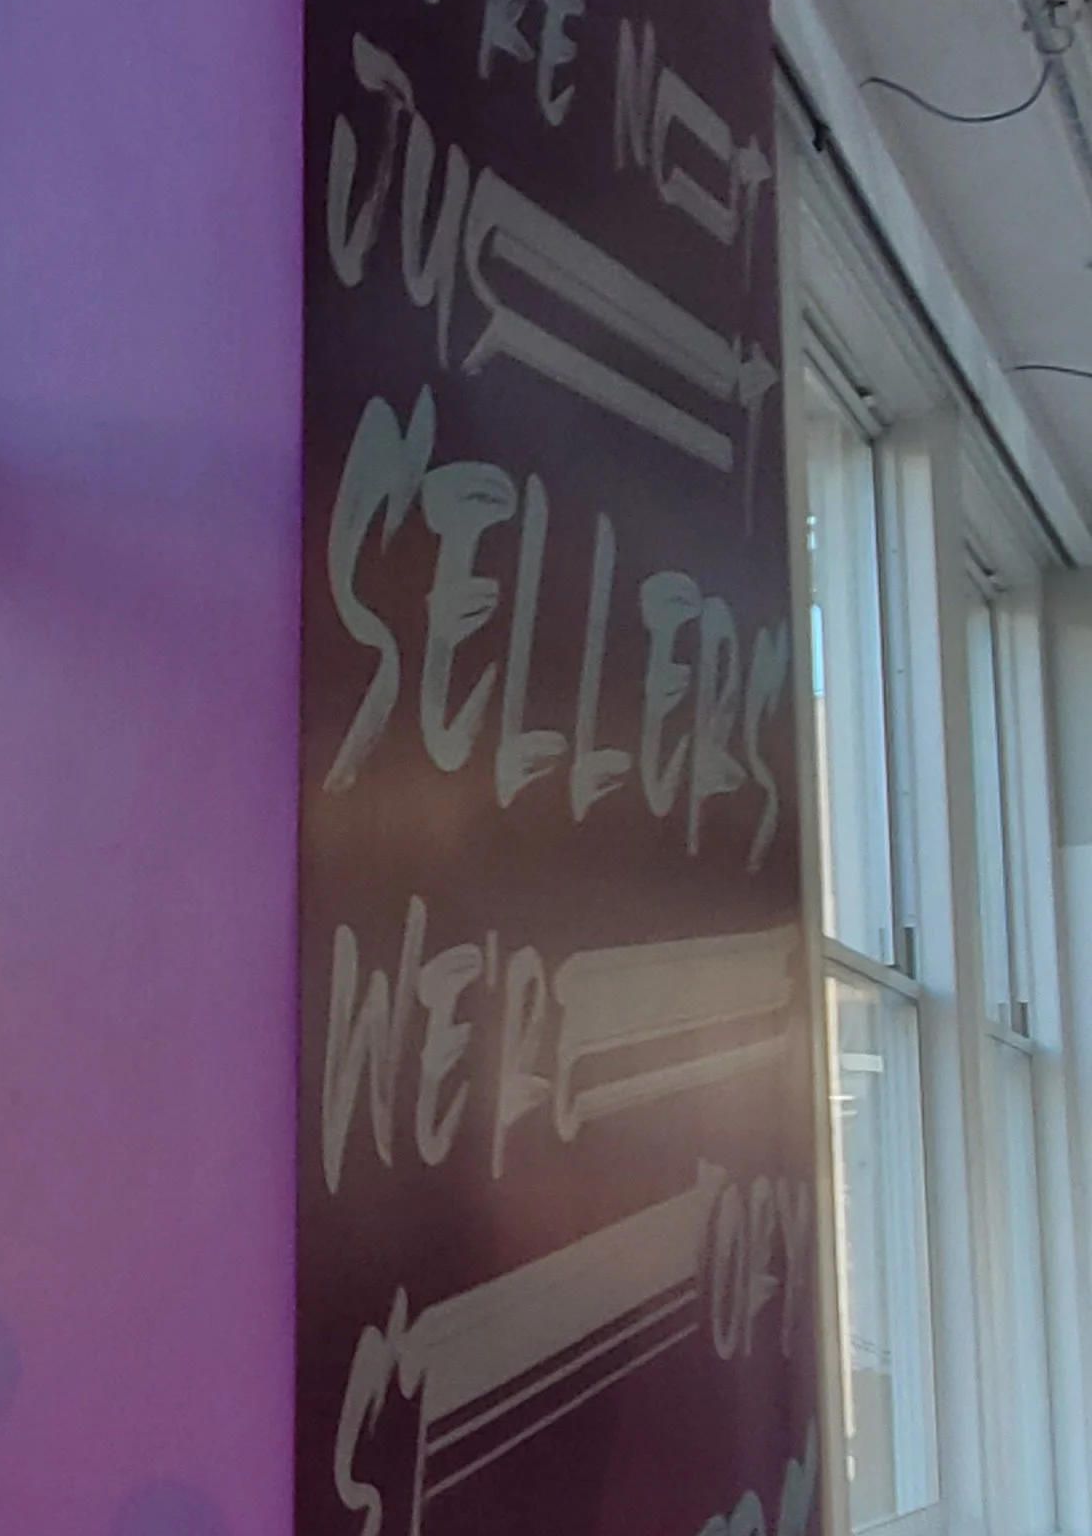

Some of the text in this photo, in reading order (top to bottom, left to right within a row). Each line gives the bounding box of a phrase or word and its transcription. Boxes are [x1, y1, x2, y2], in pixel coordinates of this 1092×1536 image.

[326, 31, 778, 538] JUST
[614, 17, 773, 293] NOT
[323, 383, 788, 872] SELLERS
[322, 895, 799, 1195] WE'RE
